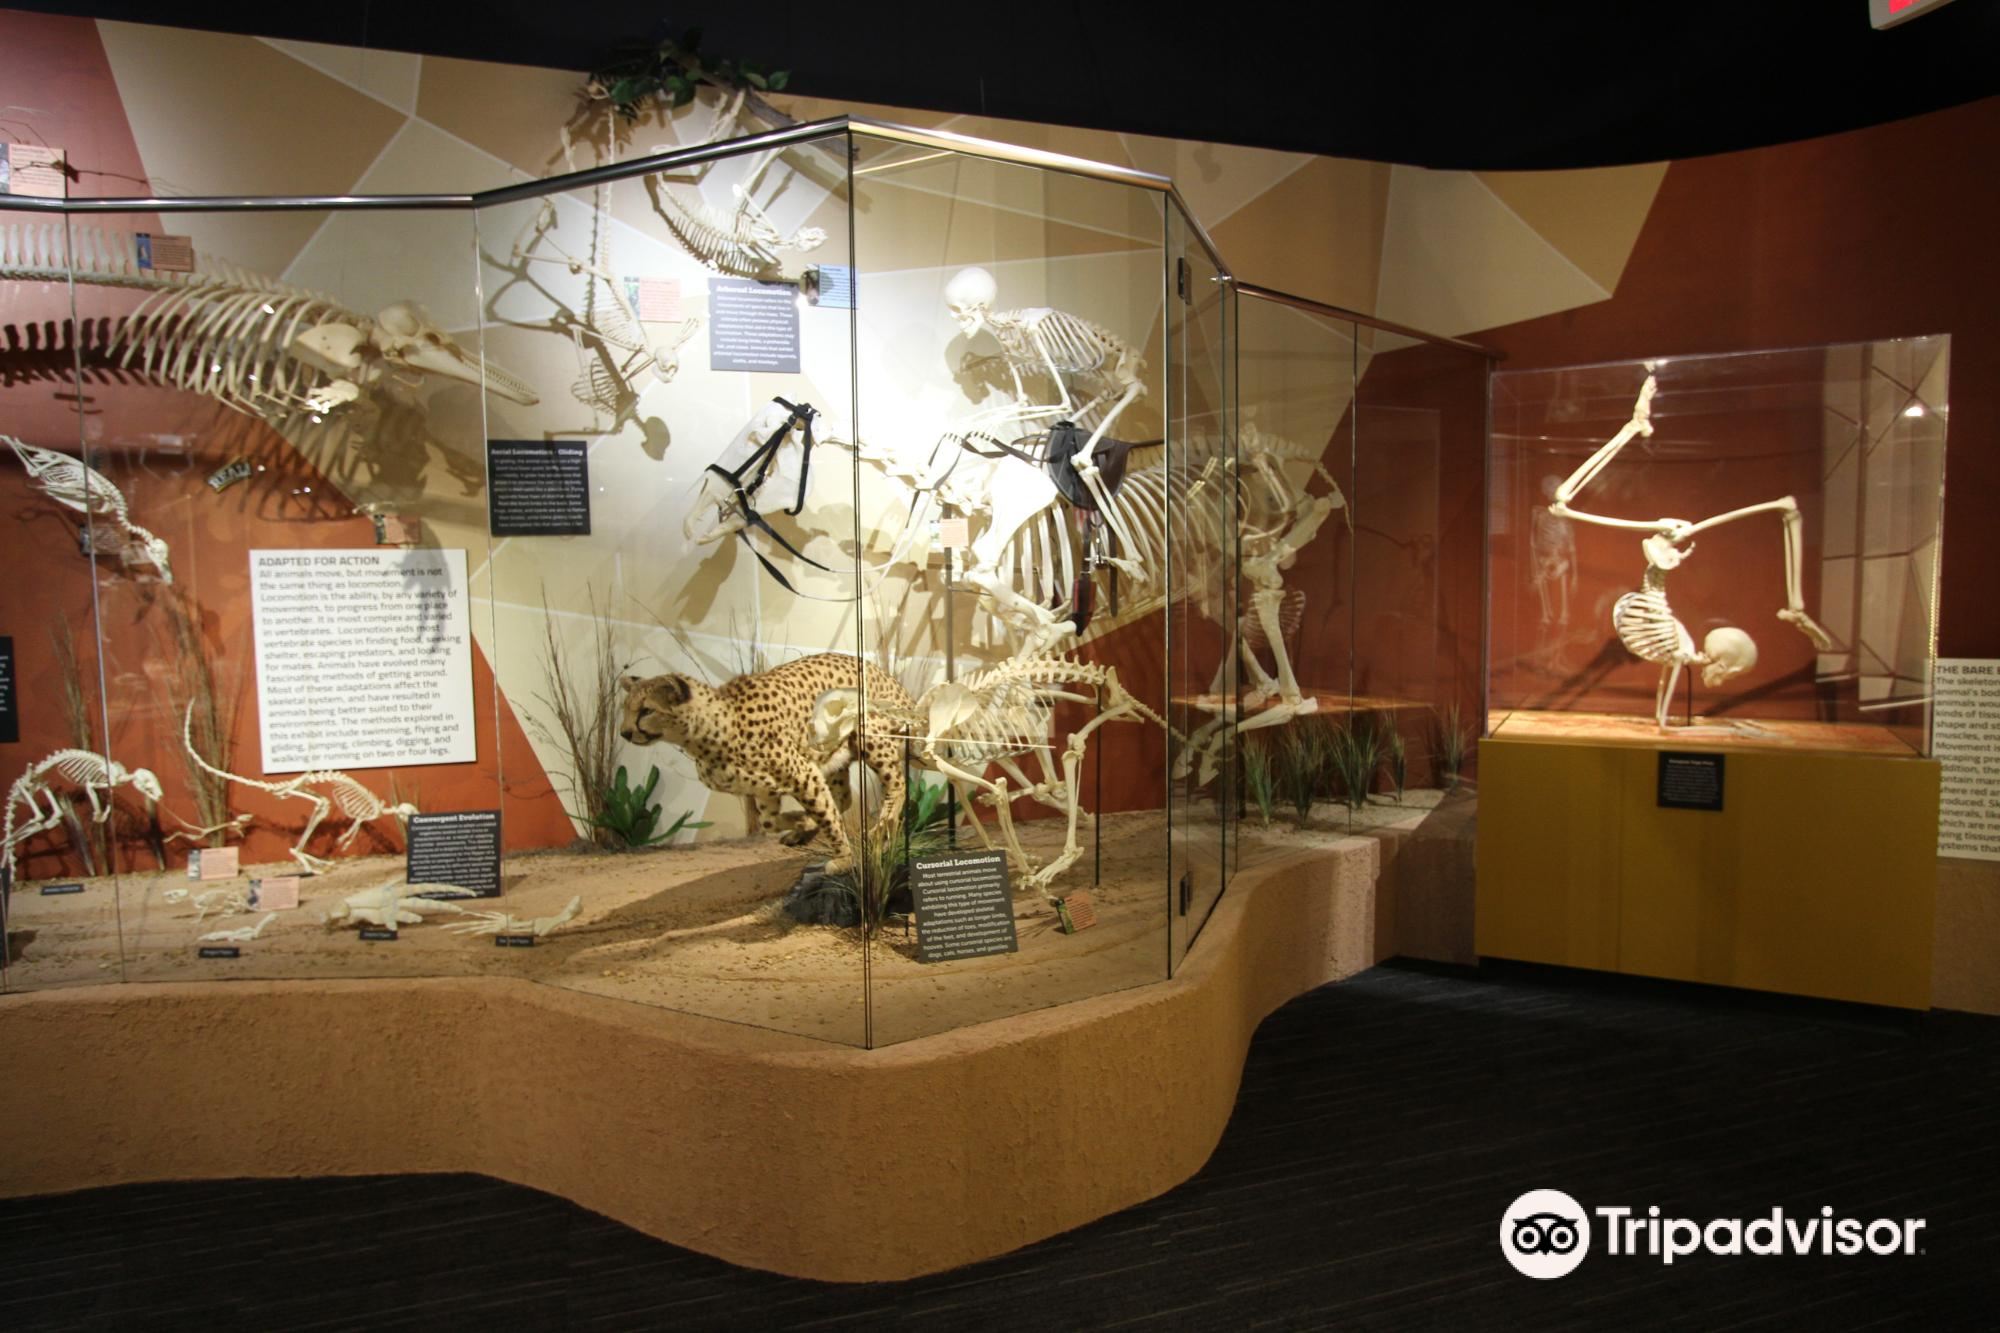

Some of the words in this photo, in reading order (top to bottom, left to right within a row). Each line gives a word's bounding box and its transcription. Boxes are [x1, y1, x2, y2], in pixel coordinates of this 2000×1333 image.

[258, 557, 311, 566] ADAPTED
[313, 557, 336, 565] FOR
[339, 557, 379, 565] ACTION
[259, 569, 271, 577] All
[274, 569, 312, 577] animals
[346, 568, 362, 576] but
[416, 568, 425, 576] is
[426, 568, 442, 576] not
[259, 581, 276, 589] the
[307, 580, 332, 591] thing
[260, 592, 318, 601] Locomotion
[320, 592, 328, 600] is
[330, 592, 346, 600] the
[382, 591, 392, 601] by
[395, 592, 412, 601] any
[414, 590, 446, 601] variety
[447, 590, 457, 598] of
[324, 603, 334, 611] to
[336, 604, 378, 614] progress
[380, 602, 402, 610] from
[262, 616, 272, 624] to
[317, 615, 325, 623] It
[327, 615, 334, 623] is
[337, 614, 361, 622] most
[363, 613, 402, 624] complex
[404, 613, 421, 621] and
[263, 627, 272, 636] in
[337, 625, 392, 634] Locomotion
[395, 624, 413, 632] aids
[416, 623, 440, 632] most
[263, 638, 314, 647] vertebrate
[317, 637, 352, 648] species
[354, 637, 363, 645] in
[365, 636, 398, 647] finding
[303, 649, 345, 660] escaping
[398, 646, 415, 655] and
[265, 662, 279, 671] for
[317, 660, 355, 669] Animals
[358, 659, 380, 667] have
[382, 658, 418, 667] evolved
[420, 658, 446, 668] many
[1936, 666, 1959, 674] THE
[1962, 666, 1993, 675] BARE
[266, 672, 319, 685] fascinating
[322, 671, 363, 680] methods
[366, 670, 376, 679] of
[378, 669, 411, 681] getting
[1937, 677, 1954, 685] The
[267, 685, 291, 694] Most
[294, 684, 304, 693] of
[306, 683, 333, 692] these
[335, 681, 391, 694] adaptations
[393, 680, 420, 689] affect
[422, 679, 437, 687] the
[267, 696, 305, 706] skeletal
[348, 693, 365, 702] and
[367, 692, 390, 701] have
[392, 691, 429, 700] resulted
[431, 690, 440, 698] in
[268, 707, 306, 717] animals
[309, 706, 335, 718] being
[337, 705, 366, 714] better
[368, 703, 397, 712] suited
[399, 703, 409, 711] to
[411, 701, 432, 710] their
[341, 716, 358, 725] The
[360, 714, 401, 724] methods
[403, 712, 442, 724] explored
[445, 712, 453, 720] in
[270, 732, 288, 741] this
[290, 730, 322, 739] exhibit
[325, 728, 359, 737] include
[414, 723, 440, 735] flying
[442, 722, 458, 731] and
[433, 734, 450, 742] and
[1936, 742, 1991, 751] Movement
[271, 753, 309, 766] walking
[324, 750, 360, 763] running
[376, 748, 395, 757] two
[408, 746, 427, 755] four
[413, 815, 458, 824] Convergent
[458, 813, 495, 822] Evolution
[915, 860, 953, 869] Cursorial
[953, 856, 1001, 866] Locomotion
